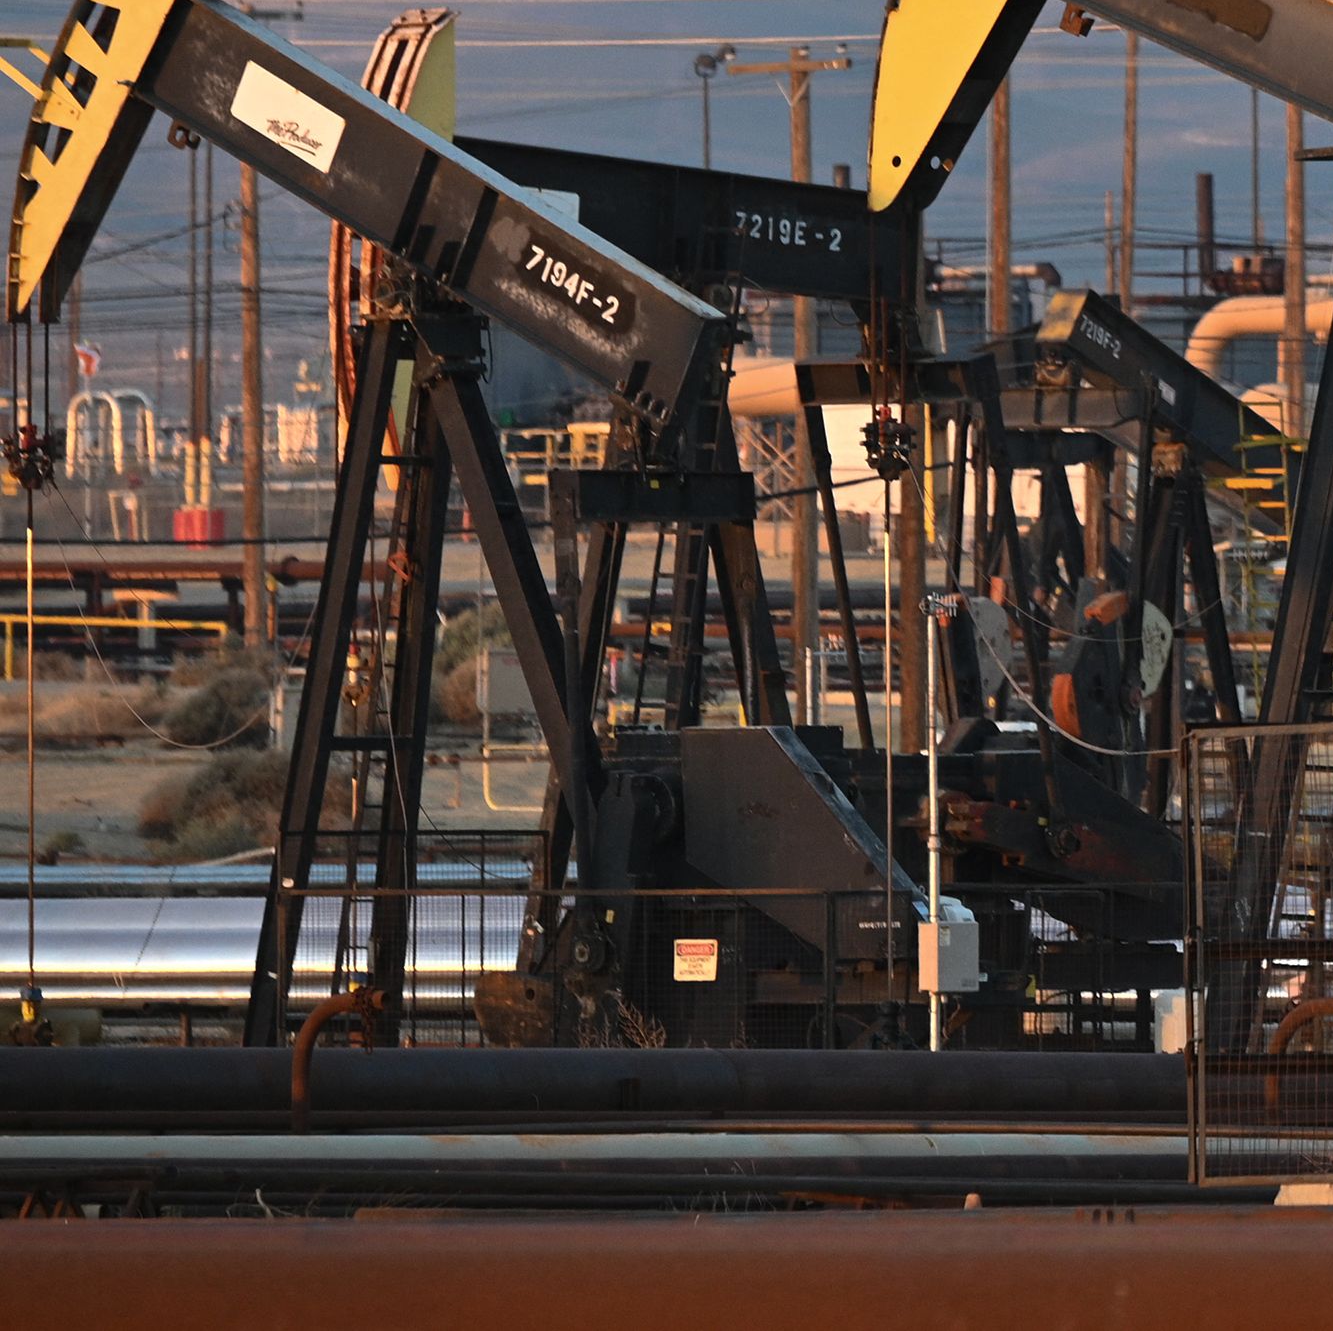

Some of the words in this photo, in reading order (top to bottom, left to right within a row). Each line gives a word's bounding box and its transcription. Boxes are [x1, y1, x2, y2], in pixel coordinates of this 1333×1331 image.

[735, 211, 842, 252] 7219E-2
[525, 244, 620, 325] 7194F-2
[1081, 314, 1121, 360] 7219F-2
